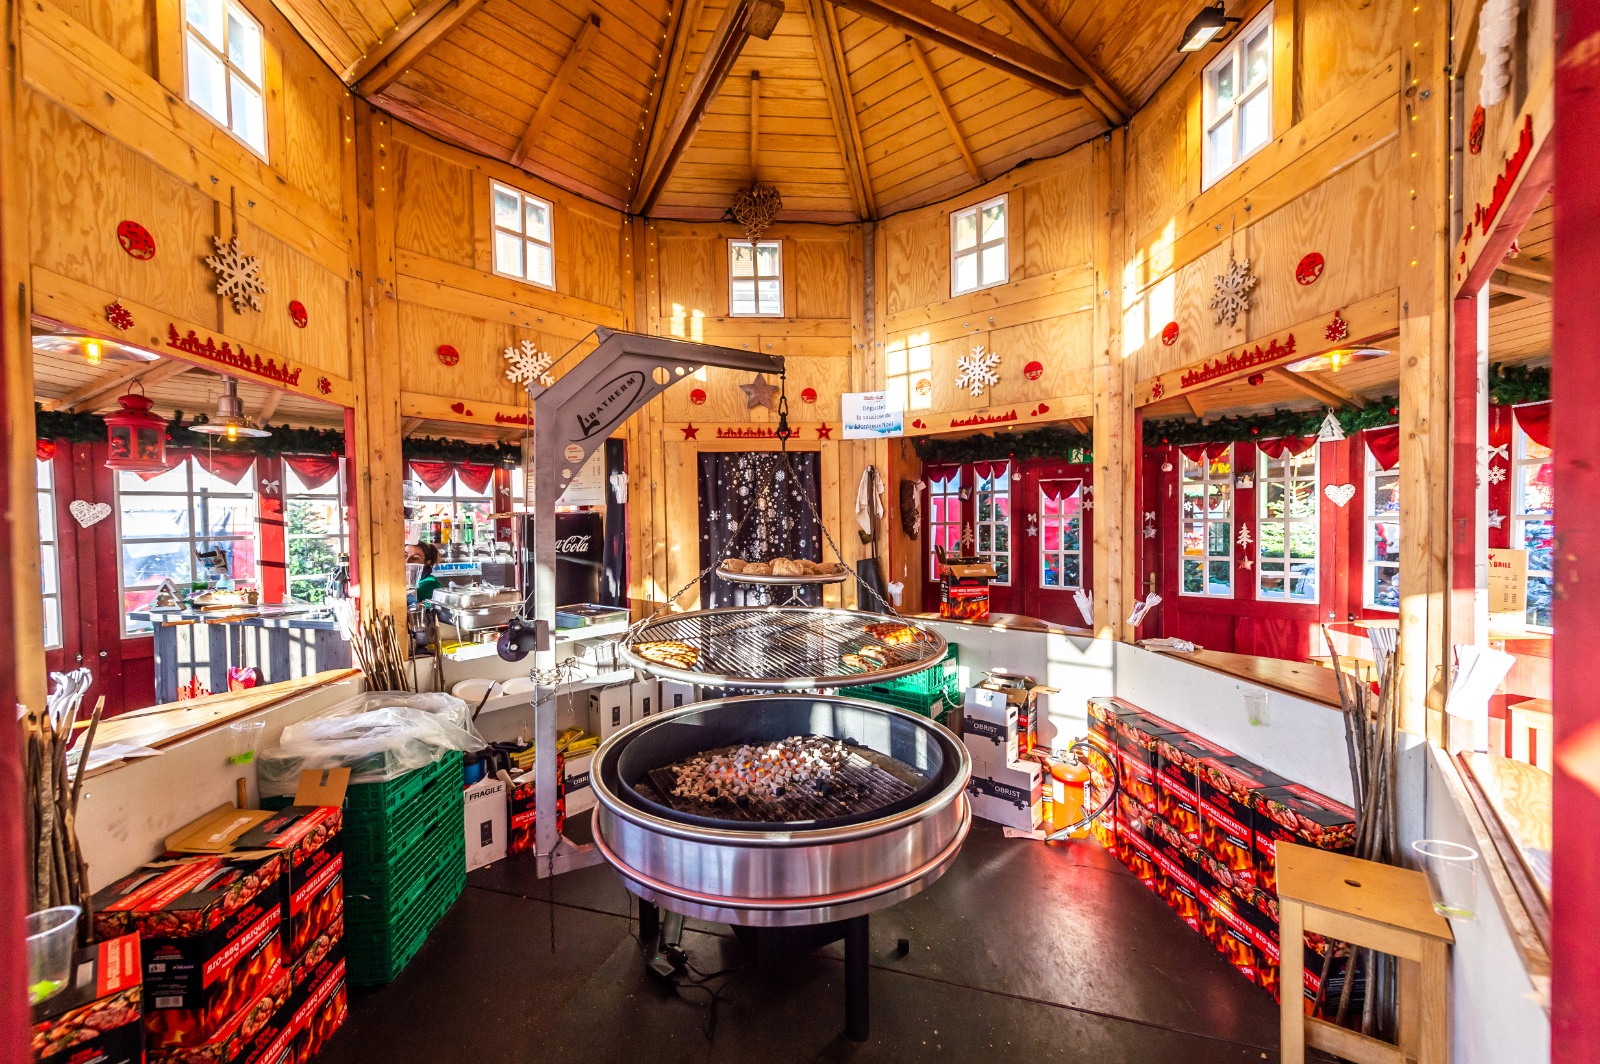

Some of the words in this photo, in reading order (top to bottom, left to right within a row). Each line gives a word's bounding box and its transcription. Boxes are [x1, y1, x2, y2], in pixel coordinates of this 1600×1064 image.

[577, 377, 636, 436] LIBATHERM
[555, 535, 591, 553] a-Cola
[974, 722, 998, 734] OBRIST
[573, 775, 590, 786] OBRI
[469, 785, 502, 800] FRAGILE
[994, 785, 1021, 798] OBRIST
[238, 902, 256, 921] TOM
[1220, 904, 1252, 934] BRIQUETTES
[206, 942, 240, 974] BIO-BBQ
[241, 907, 281, 944] BRIQUETTES
[318, 960, 346, 994] BRIQUETTES
